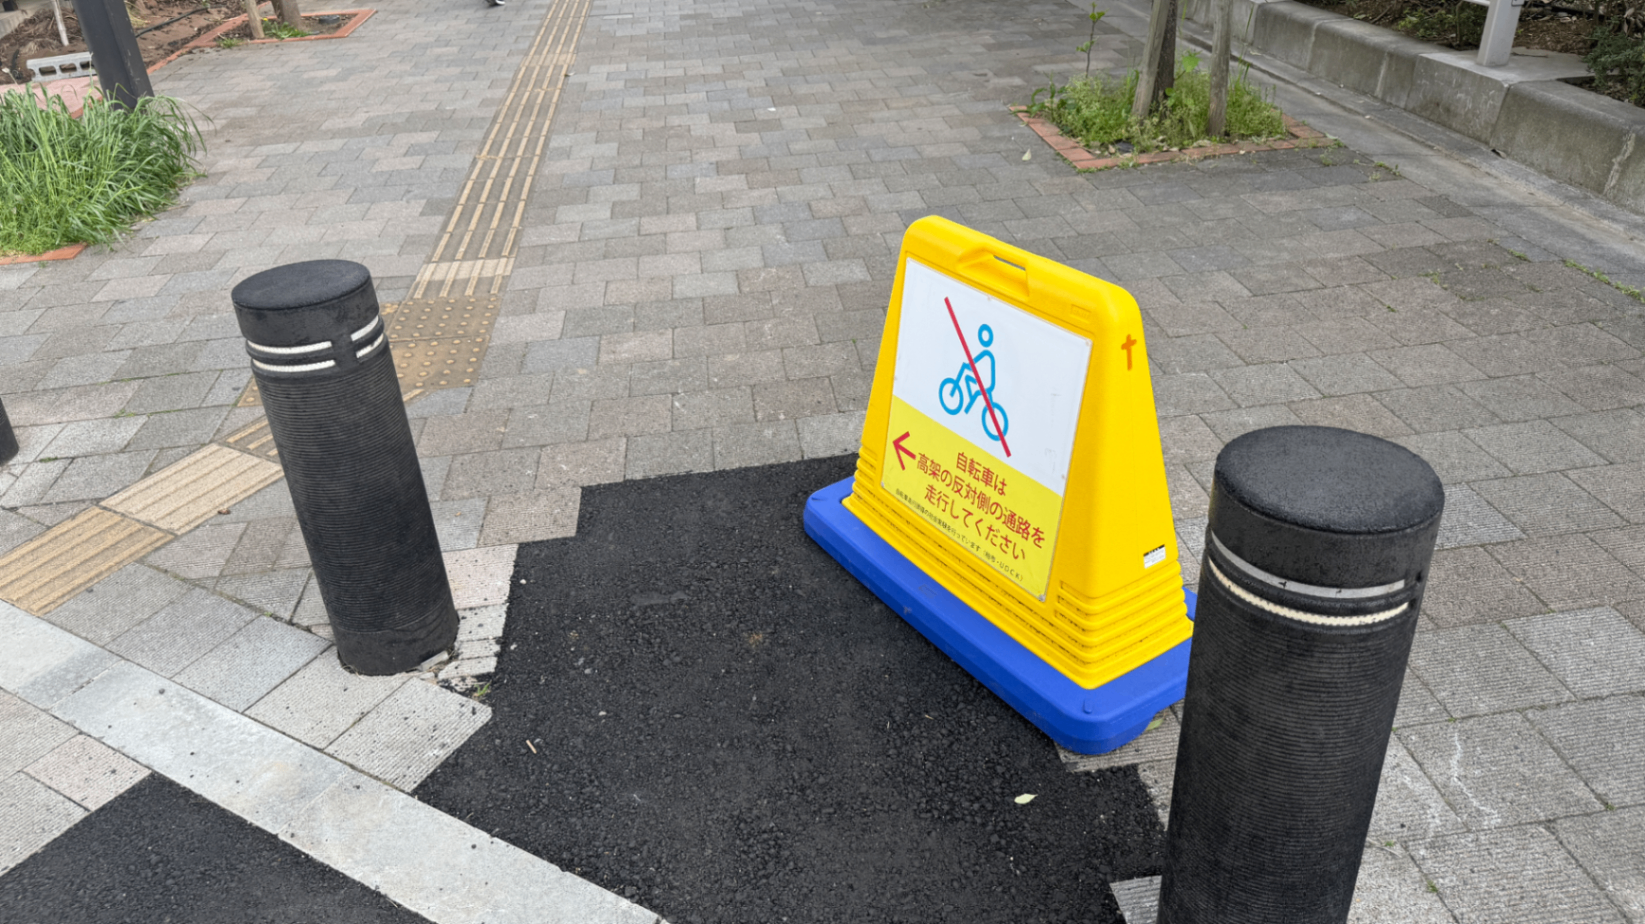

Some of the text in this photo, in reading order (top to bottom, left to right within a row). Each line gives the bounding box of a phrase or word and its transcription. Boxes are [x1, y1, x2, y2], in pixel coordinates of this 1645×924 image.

[917, 452, 1045, 549] 高架の反対側の通路を
[956, 452, 1007, 496] 自転車は
[924, 484, 1026, 560] 走行してください
